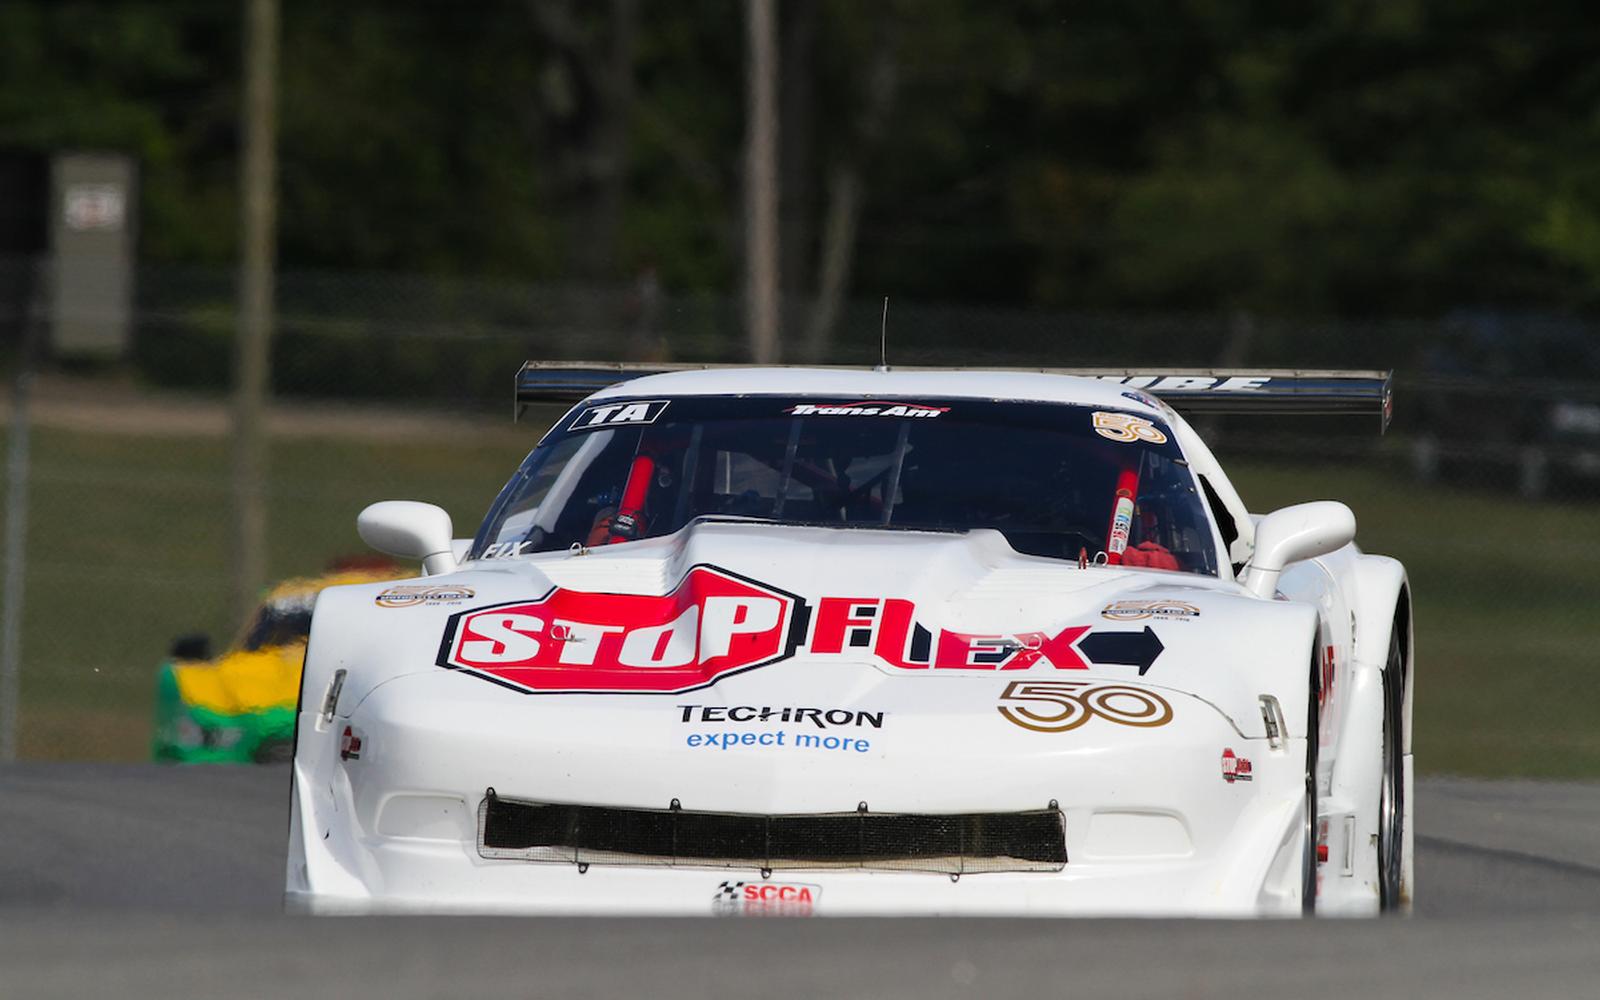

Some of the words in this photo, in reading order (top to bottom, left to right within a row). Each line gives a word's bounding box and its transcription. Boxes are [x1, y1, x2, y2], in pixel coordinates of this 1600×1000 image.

[588, 403, 650, 425] TA
[792, 404, 881, 416] Trans
[880, 405, 942, 418] Am
[1093, 411, 1167, 443] 50
[460, 596, 781, 668] STOP
[810, 597, 1093, 670] FLEX
[677, 705, 884, 729] TECHRON
[997, 681, 1174, 732] 50
[687, 730, 785, 750] expect
[795, 734, 870, 752] more
[743, 884, 814, 902] SCCA
